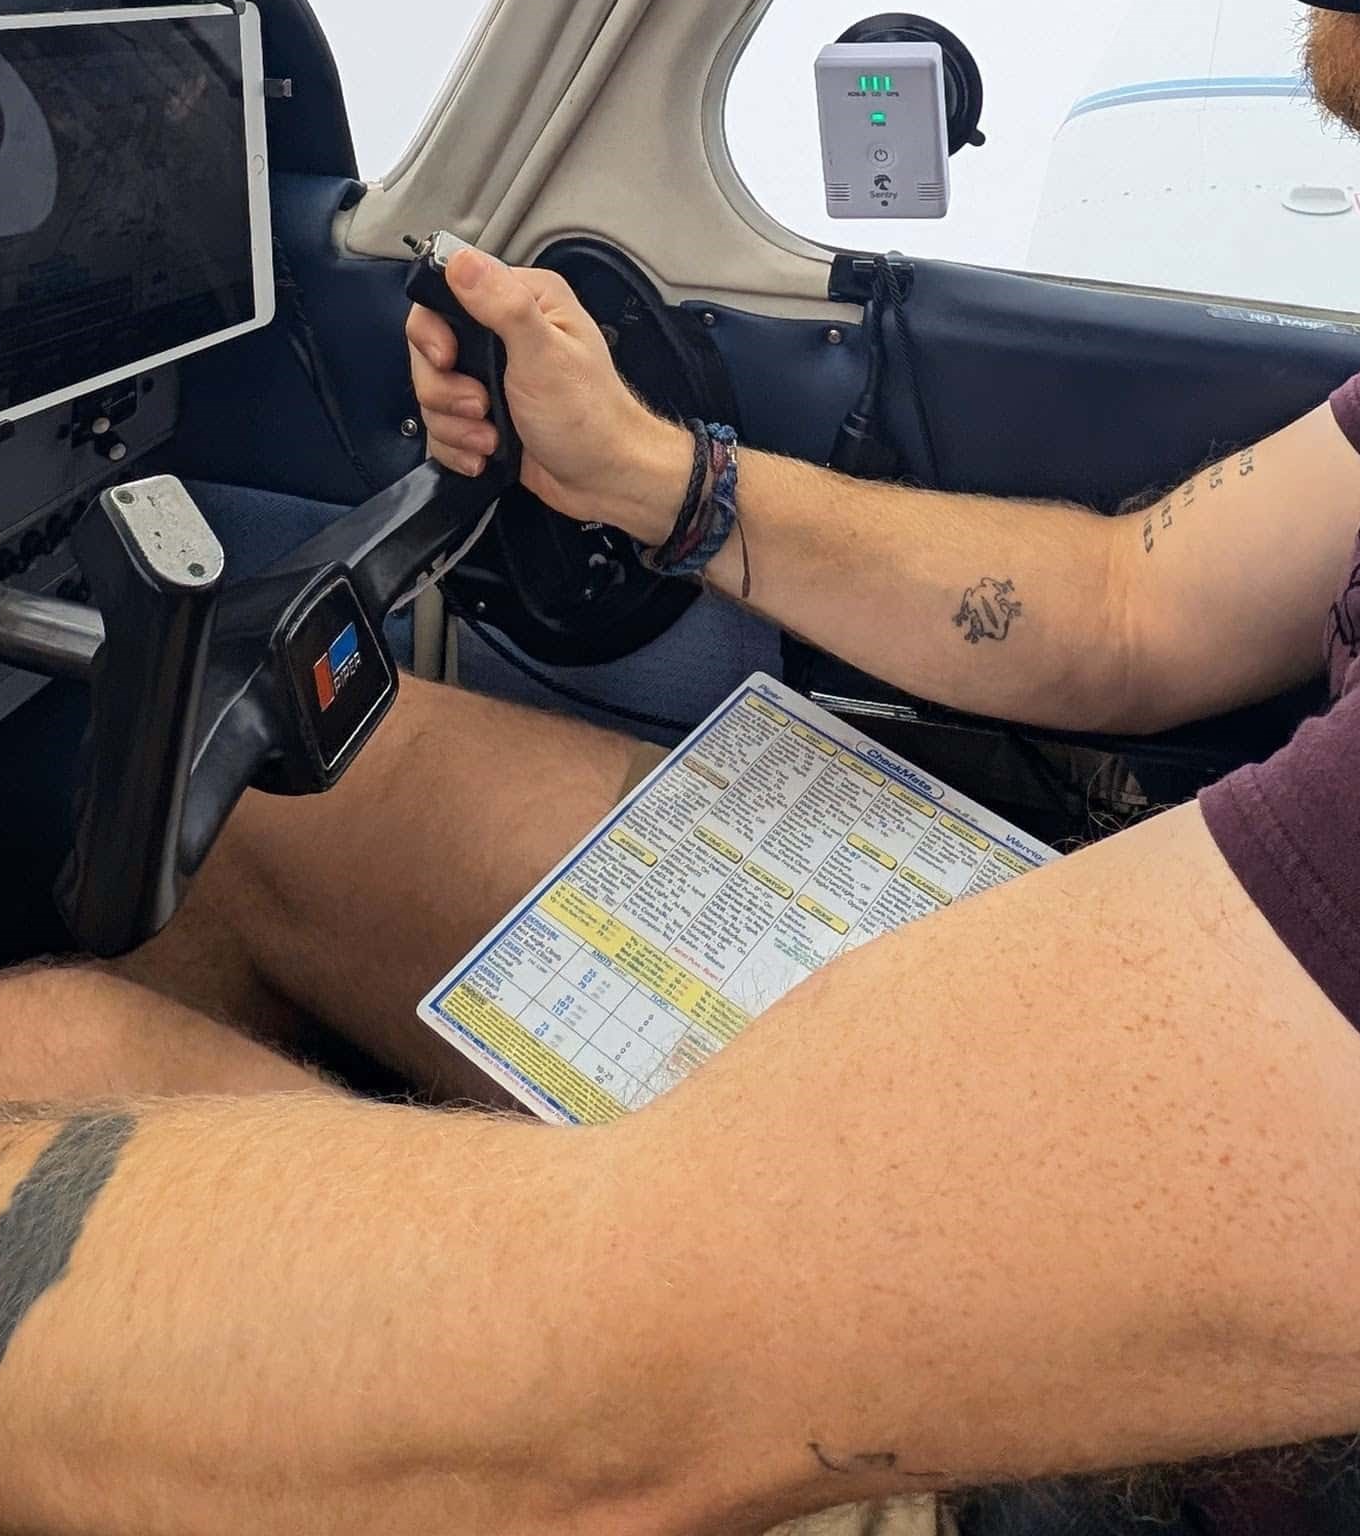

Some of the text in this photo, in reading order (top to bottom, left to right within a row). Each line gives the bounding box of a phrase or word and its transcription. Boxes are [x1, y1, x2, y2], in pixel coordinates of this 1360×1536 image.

[869, 189, 899, 201] Sentry
[332, 651, 362, 696] PIPER
[757, 683, 784, 702] Piper
[1004, 834, 1048, 863] Warrior
[525, 914, 559, 941] DEPARTURE
[501, 938, 524, 956] CRUISE
[522, 939, 537, 951] Rate
[535, 948, 554, 964] Climb
[528, 934, 546, 948] Angle
[544, 946, 563, 961] Climb
[590, 949, 613, 966] KNOTS
[467, 975, 484, 989] Short
[481, 986, 498, 1000] Final
[472, 968, 502, 992] Approach
[491, 949, 514, 967] Normal
[555, 997, 571, 1010] 103
[550, 1004, 565, 1016] 113
